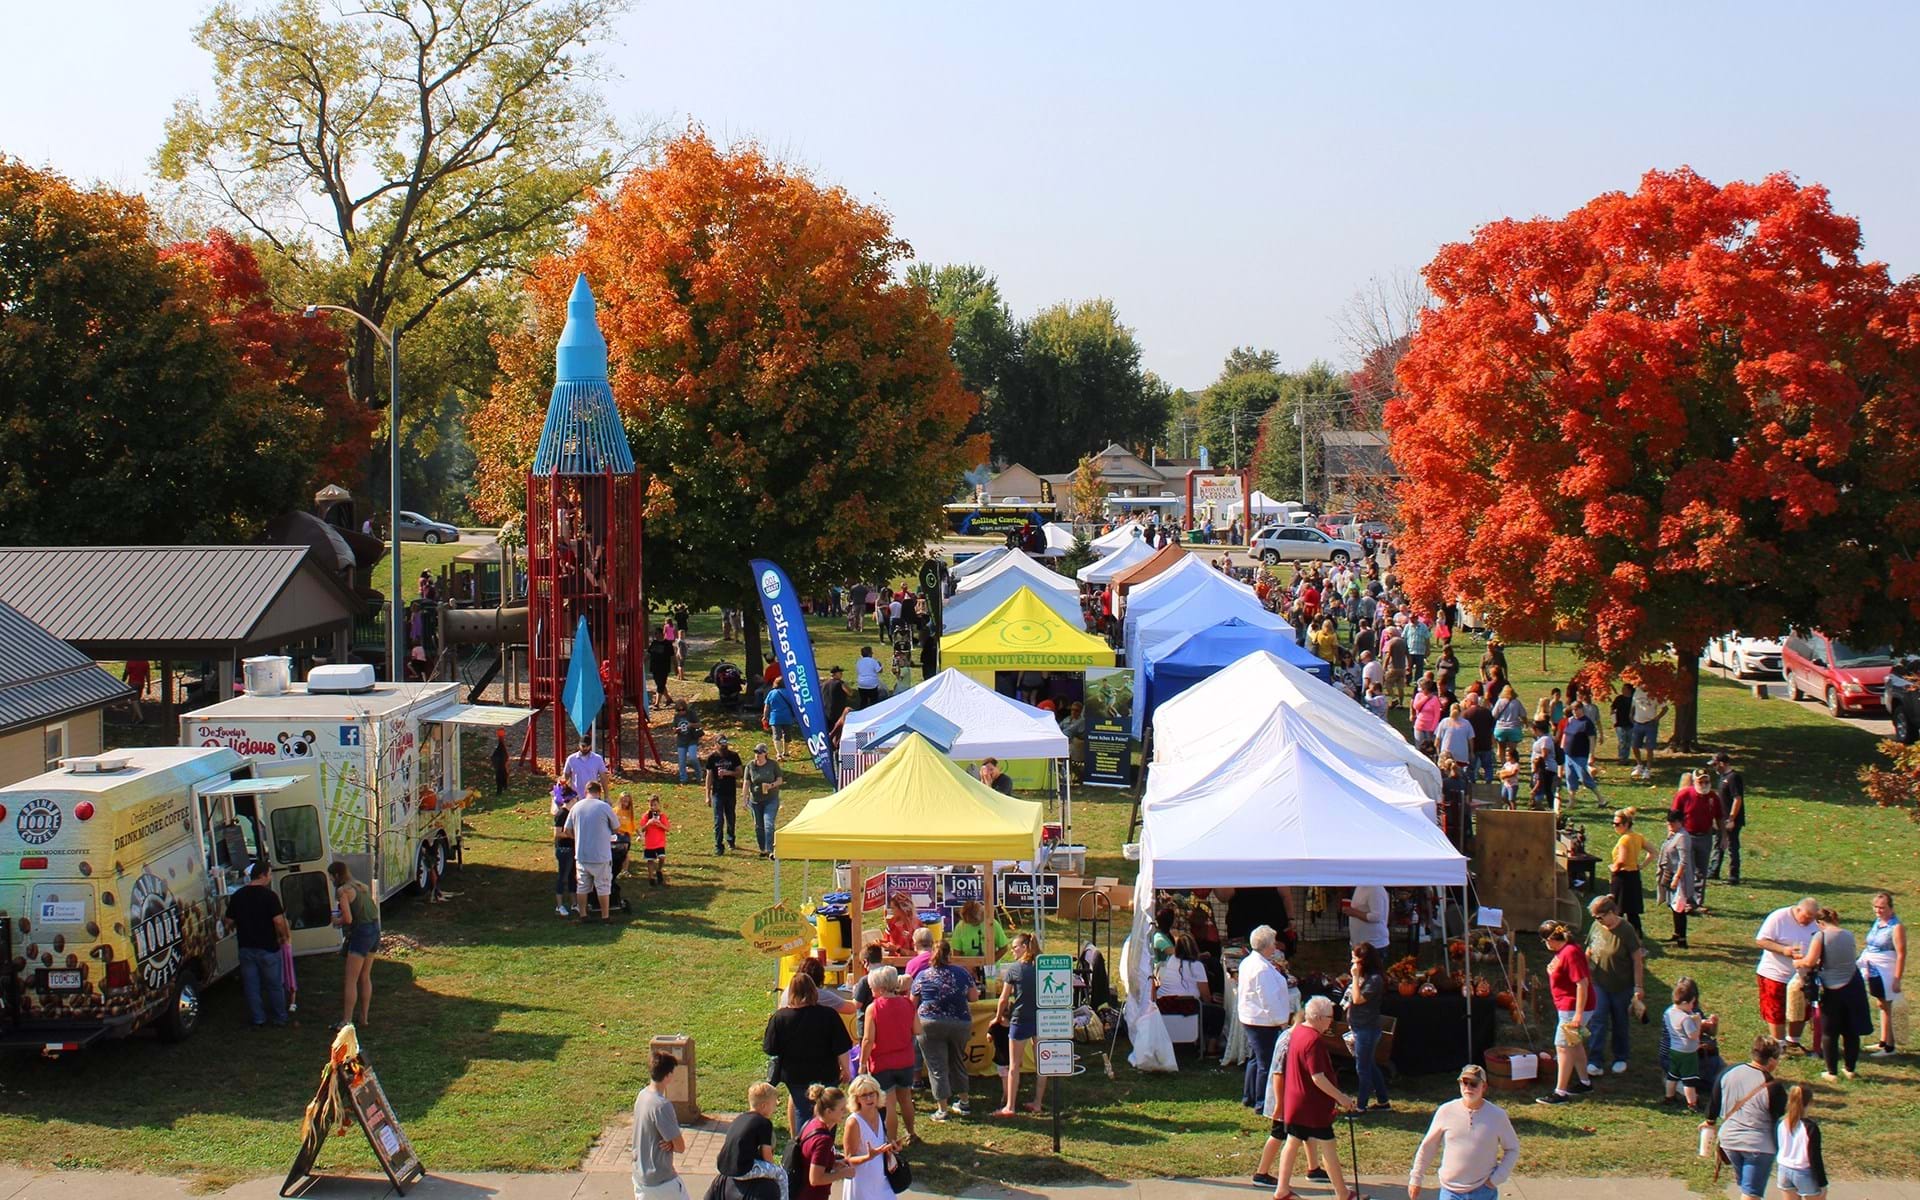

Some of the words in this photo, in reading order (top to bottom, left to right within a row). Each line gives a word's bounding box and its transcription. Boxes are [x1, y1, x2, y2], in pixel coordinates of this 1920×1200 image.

[960, 655, 984, 666] HM
[987, 654, 1094, 666] NUTRITIONALS
[19, 814, 60, 829] MOORE
[21, 829, 55, 844] COFFEE
[866, 884, 885, 900] TRUM
[890, 878, 932, 891] Shipley
[951, 875, 982, 894] joni
[134, 907, 182, 960] MOORE
[143, 948, 182, 990] COFFEE
